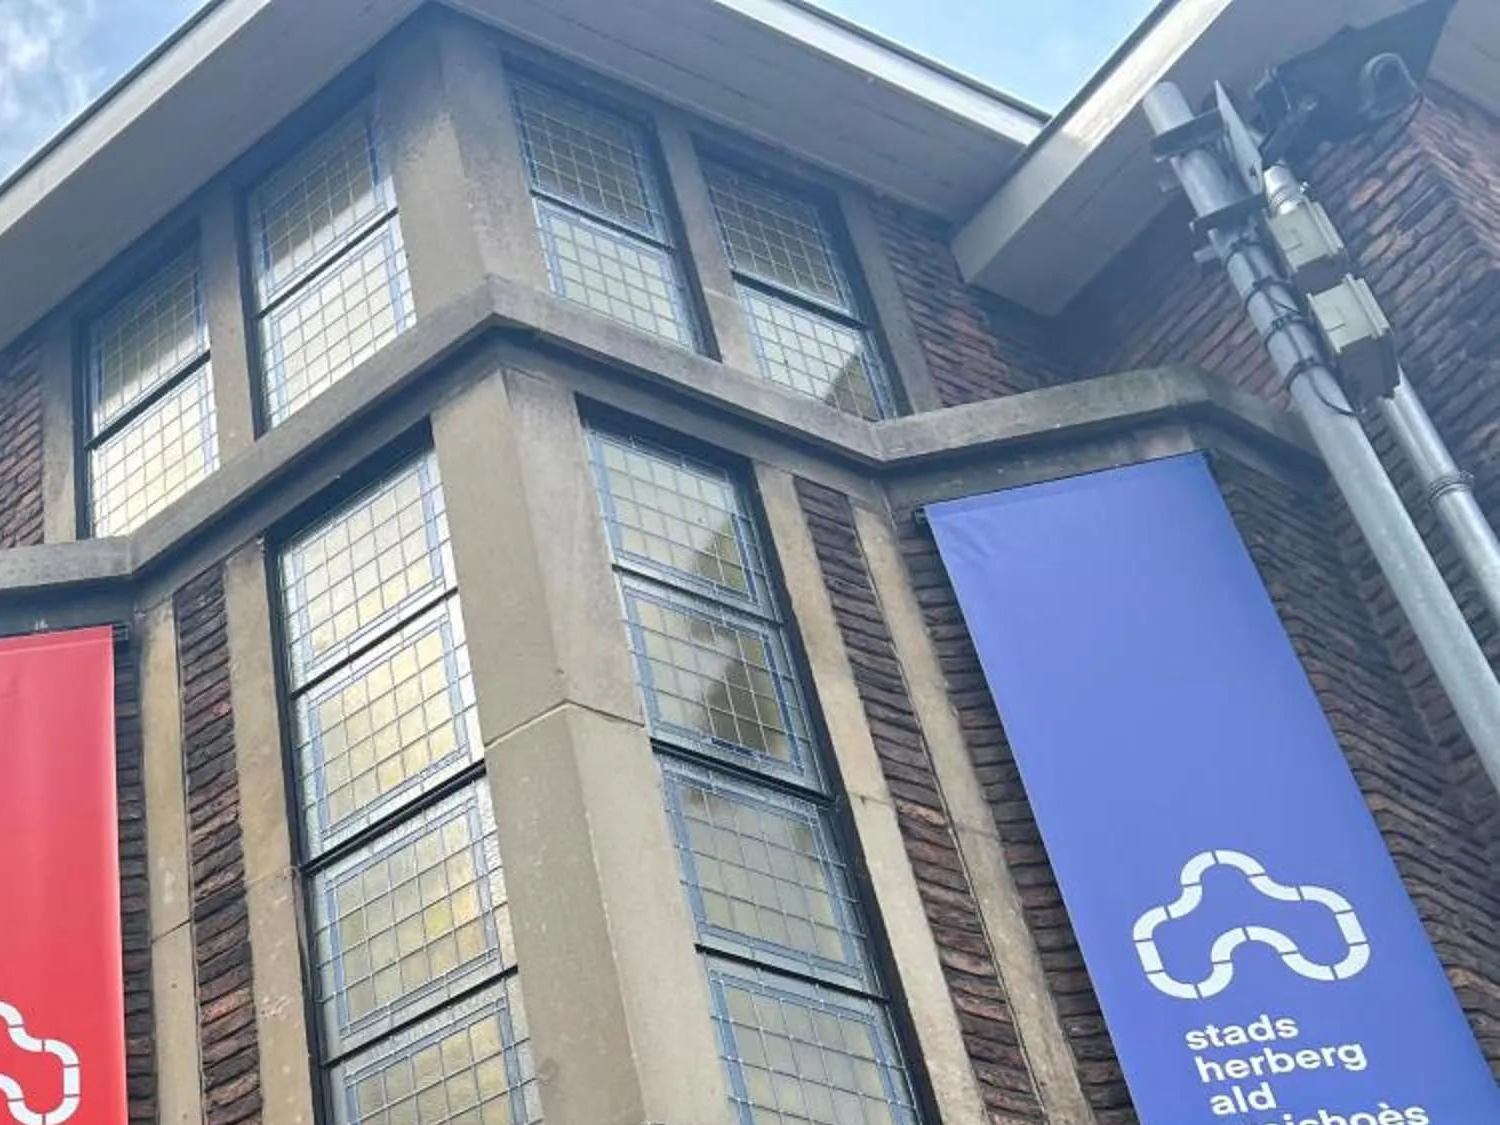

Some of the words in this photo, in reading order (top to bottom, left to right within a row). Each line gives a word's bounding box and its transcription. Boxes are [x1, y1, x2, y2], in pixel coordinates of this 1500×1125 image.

[1185, 1013, 1299, 1050] stads
[1194, 1041, 1368, 1083] herberg
[1210, 1081, 1278, 1116] ald
